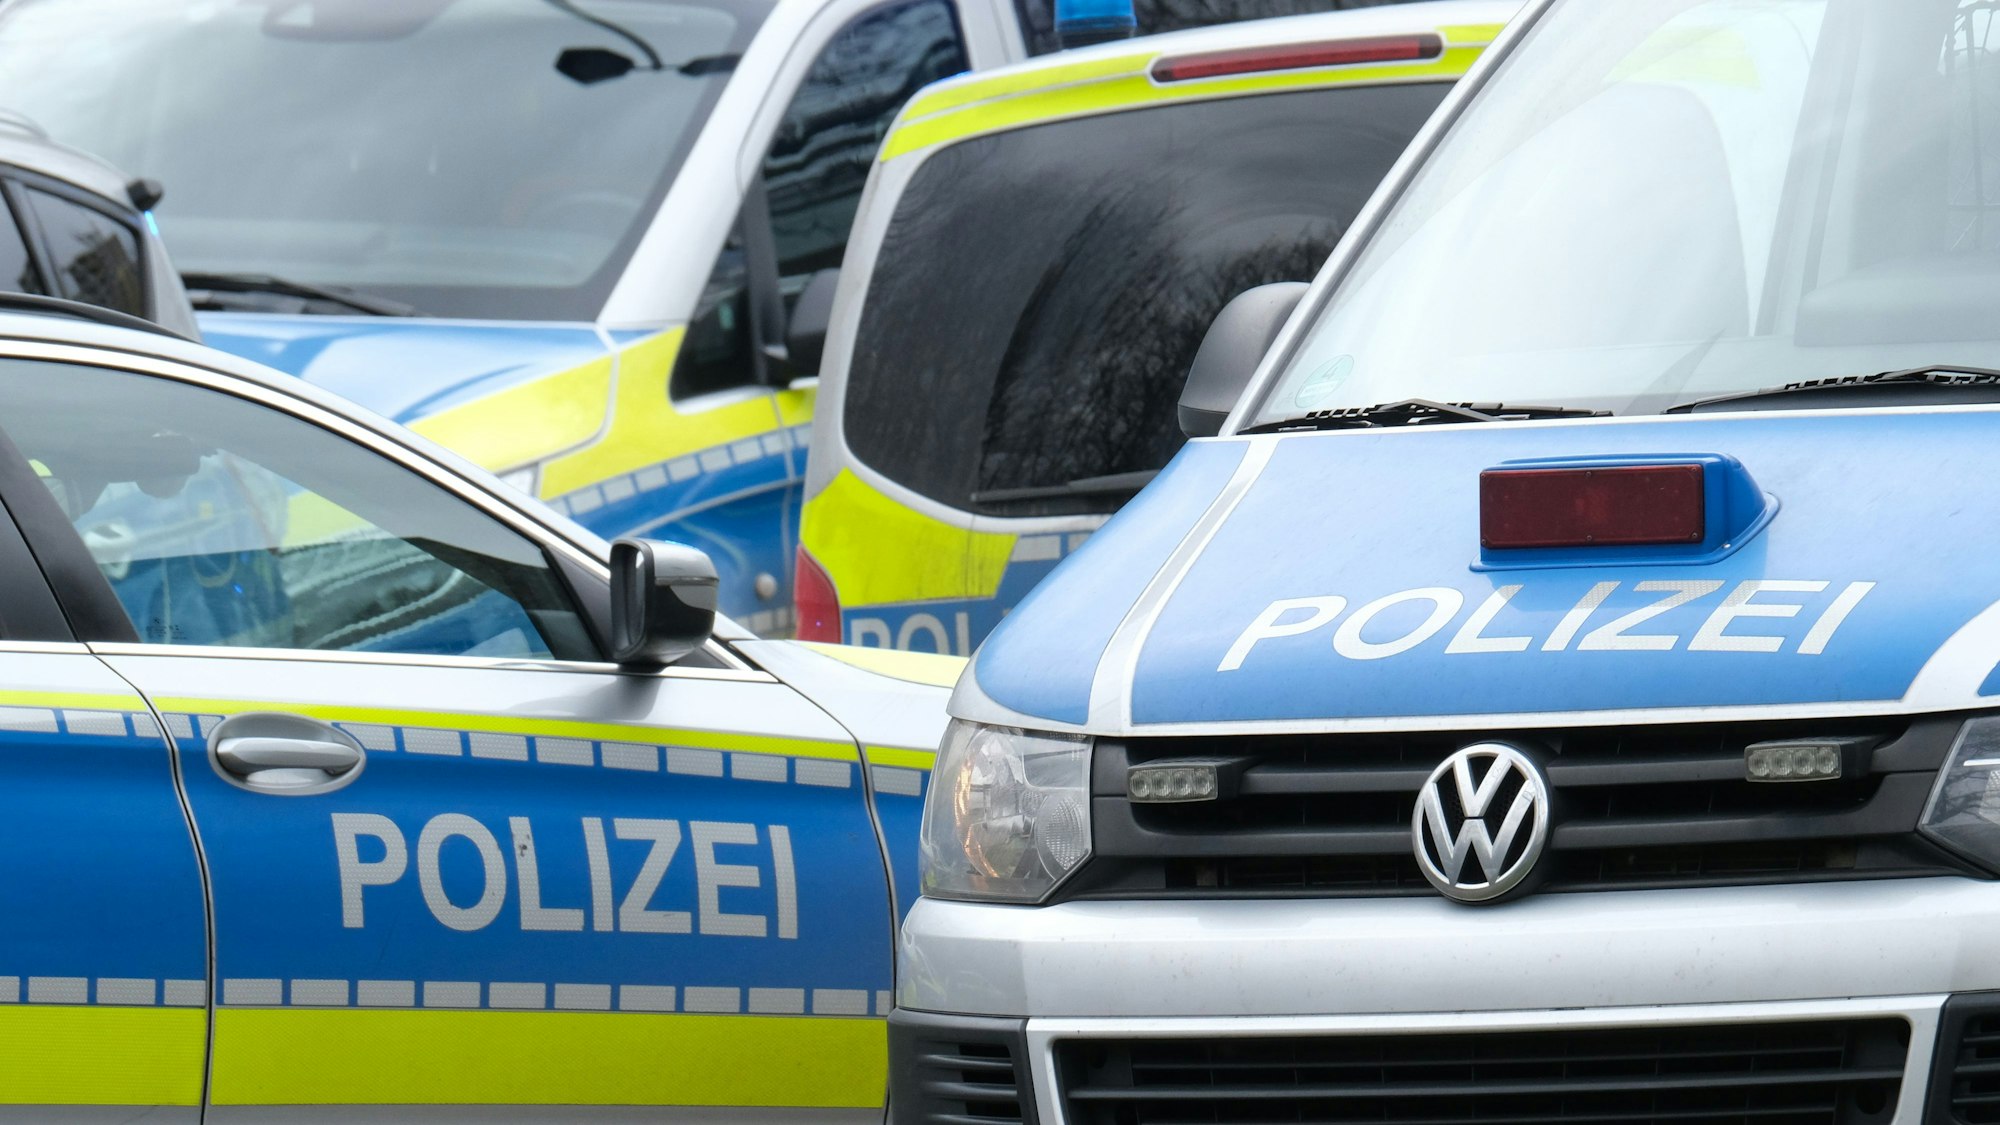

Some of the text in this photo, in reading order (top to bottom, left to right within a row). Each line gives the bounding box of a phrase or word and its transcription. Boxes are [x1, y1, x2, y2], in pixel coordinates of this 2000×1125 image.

[1216, 580, 1876, 671] POLIZEI
[331, 812, 798, 939] POLIZEI
[1418, 747, 1541, 893] VW
